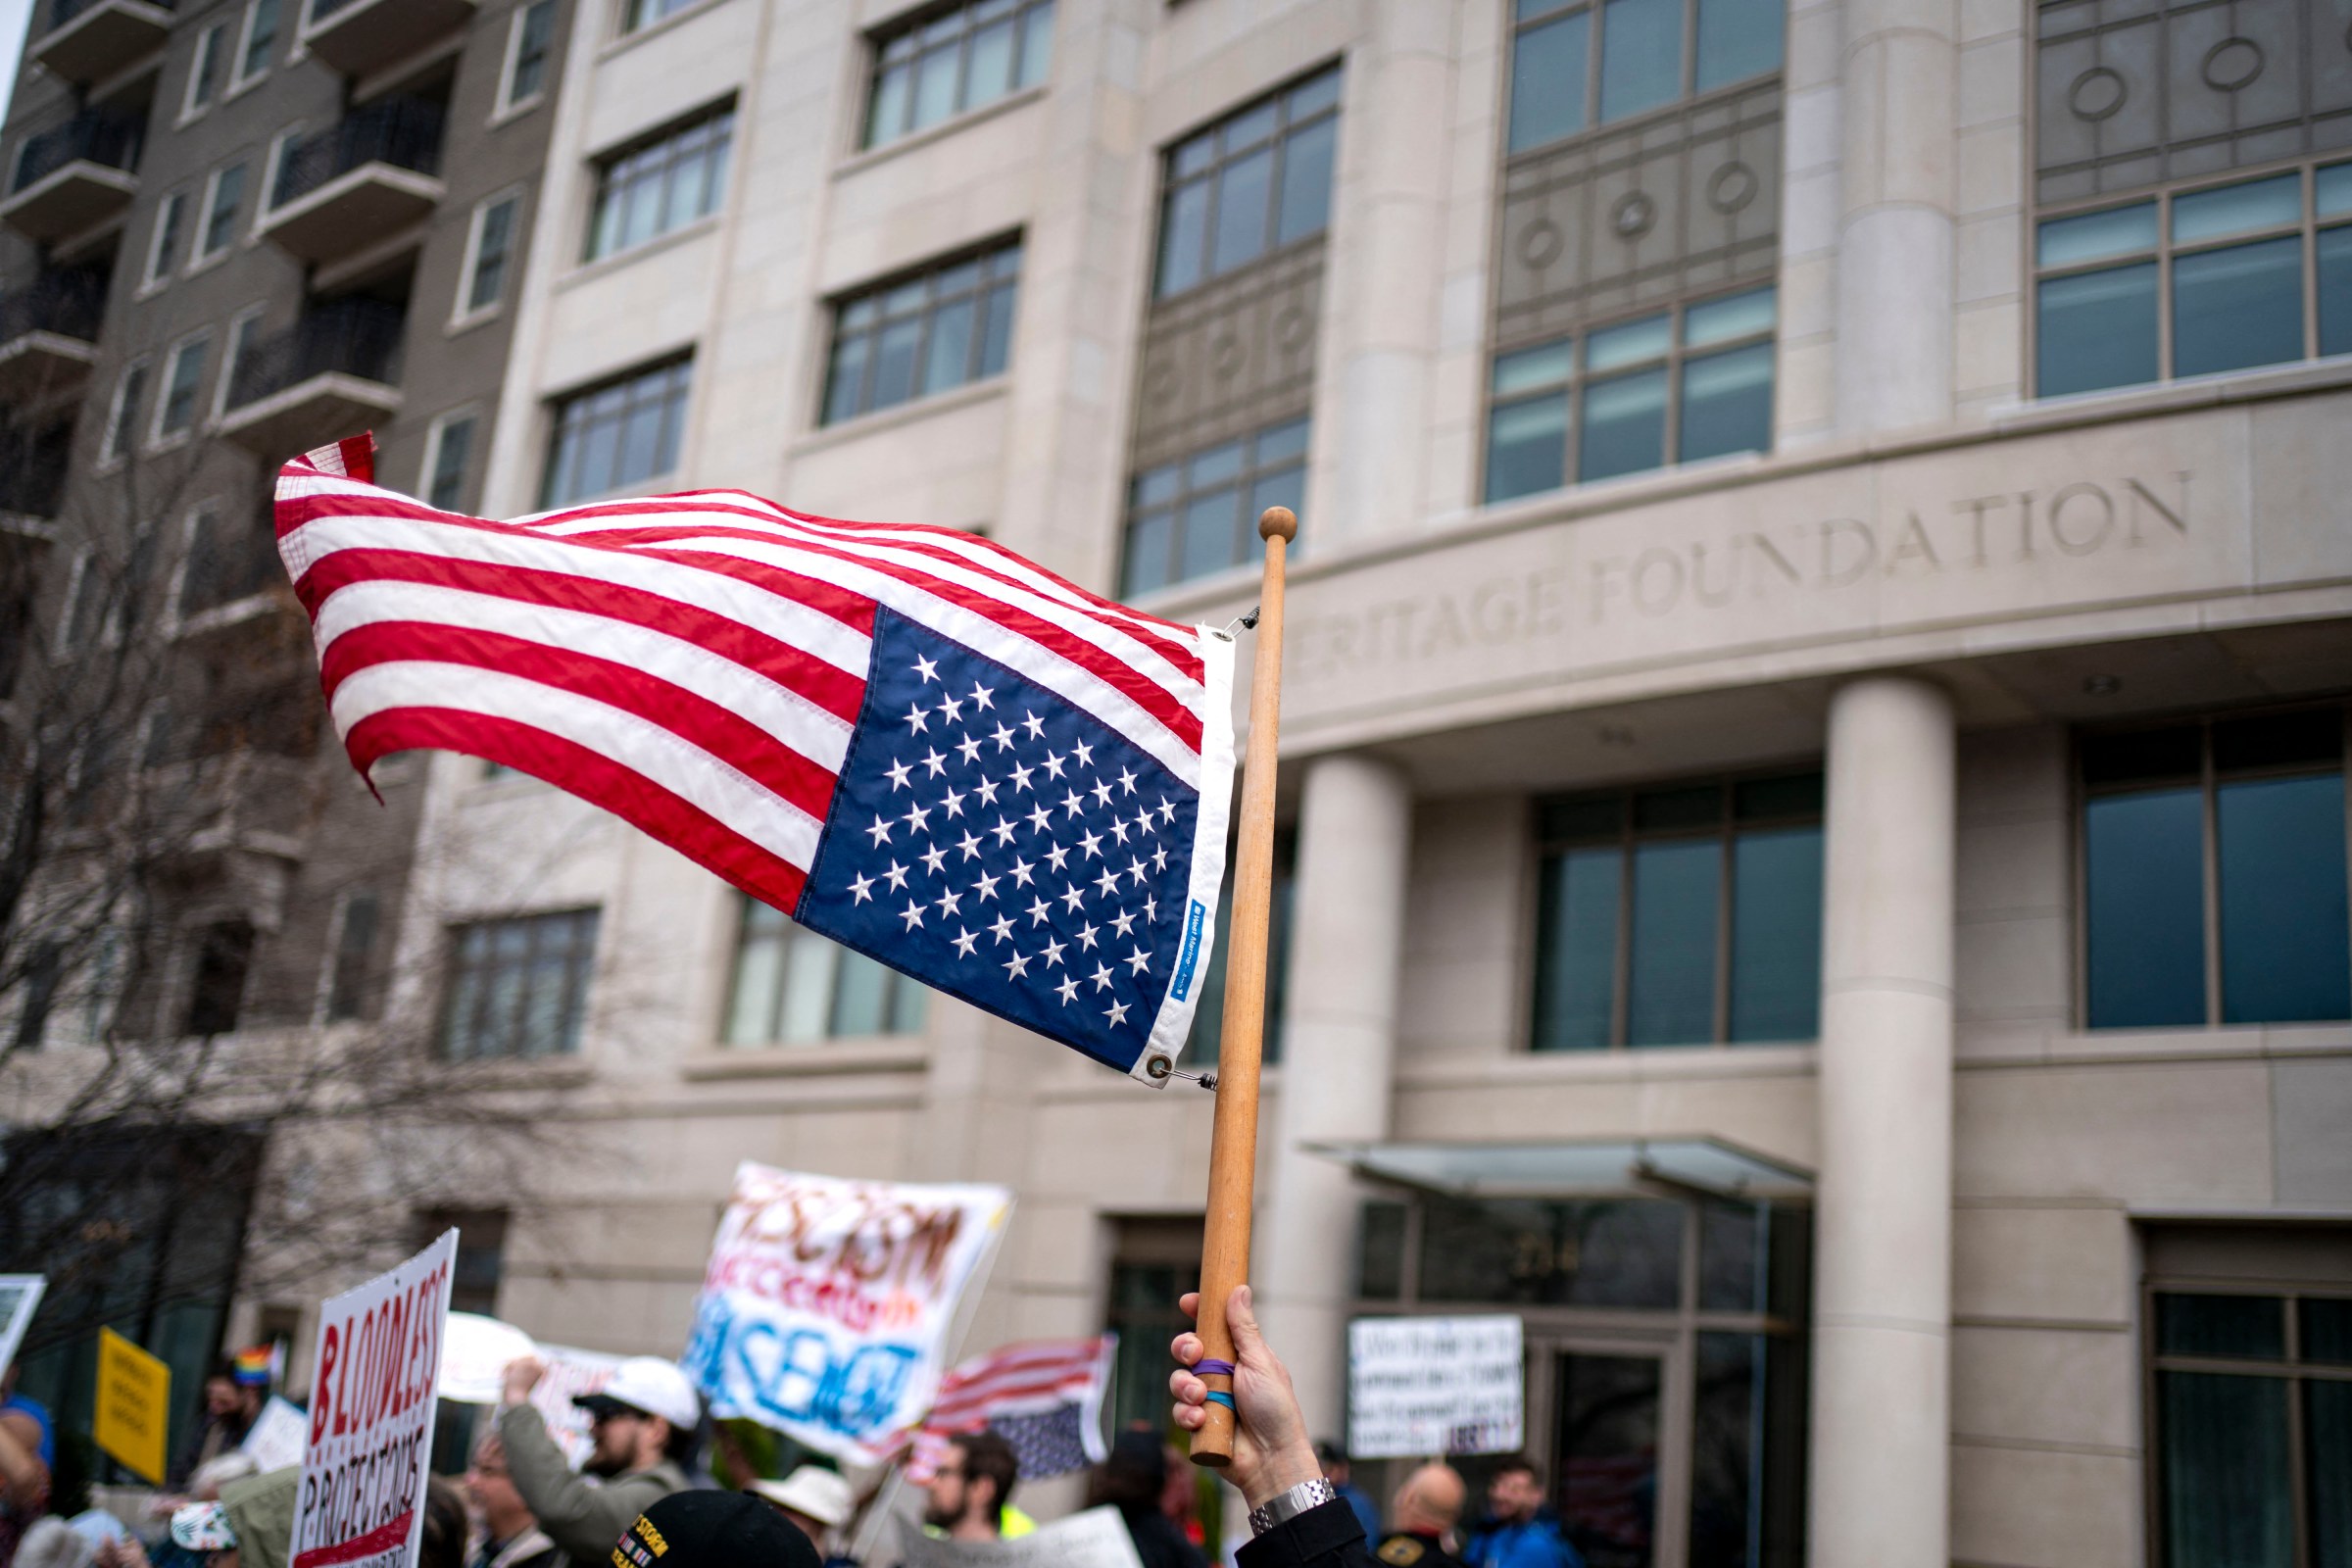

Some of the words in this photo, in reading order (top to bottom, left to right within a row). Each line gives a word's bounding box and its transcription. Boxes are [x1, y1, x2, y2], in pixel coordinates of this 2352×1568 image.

[1278, 564, 1566, 682] ERITAGE
[1587, 468, 2196, 627] FOUNDATION
[1191, 914, 1200, 936] West
[1185, 937, 1197, 965] Marine
[311, 1258, 447, 1447] BLOODLESS
[636, 1517, 668, 1558] STORM
